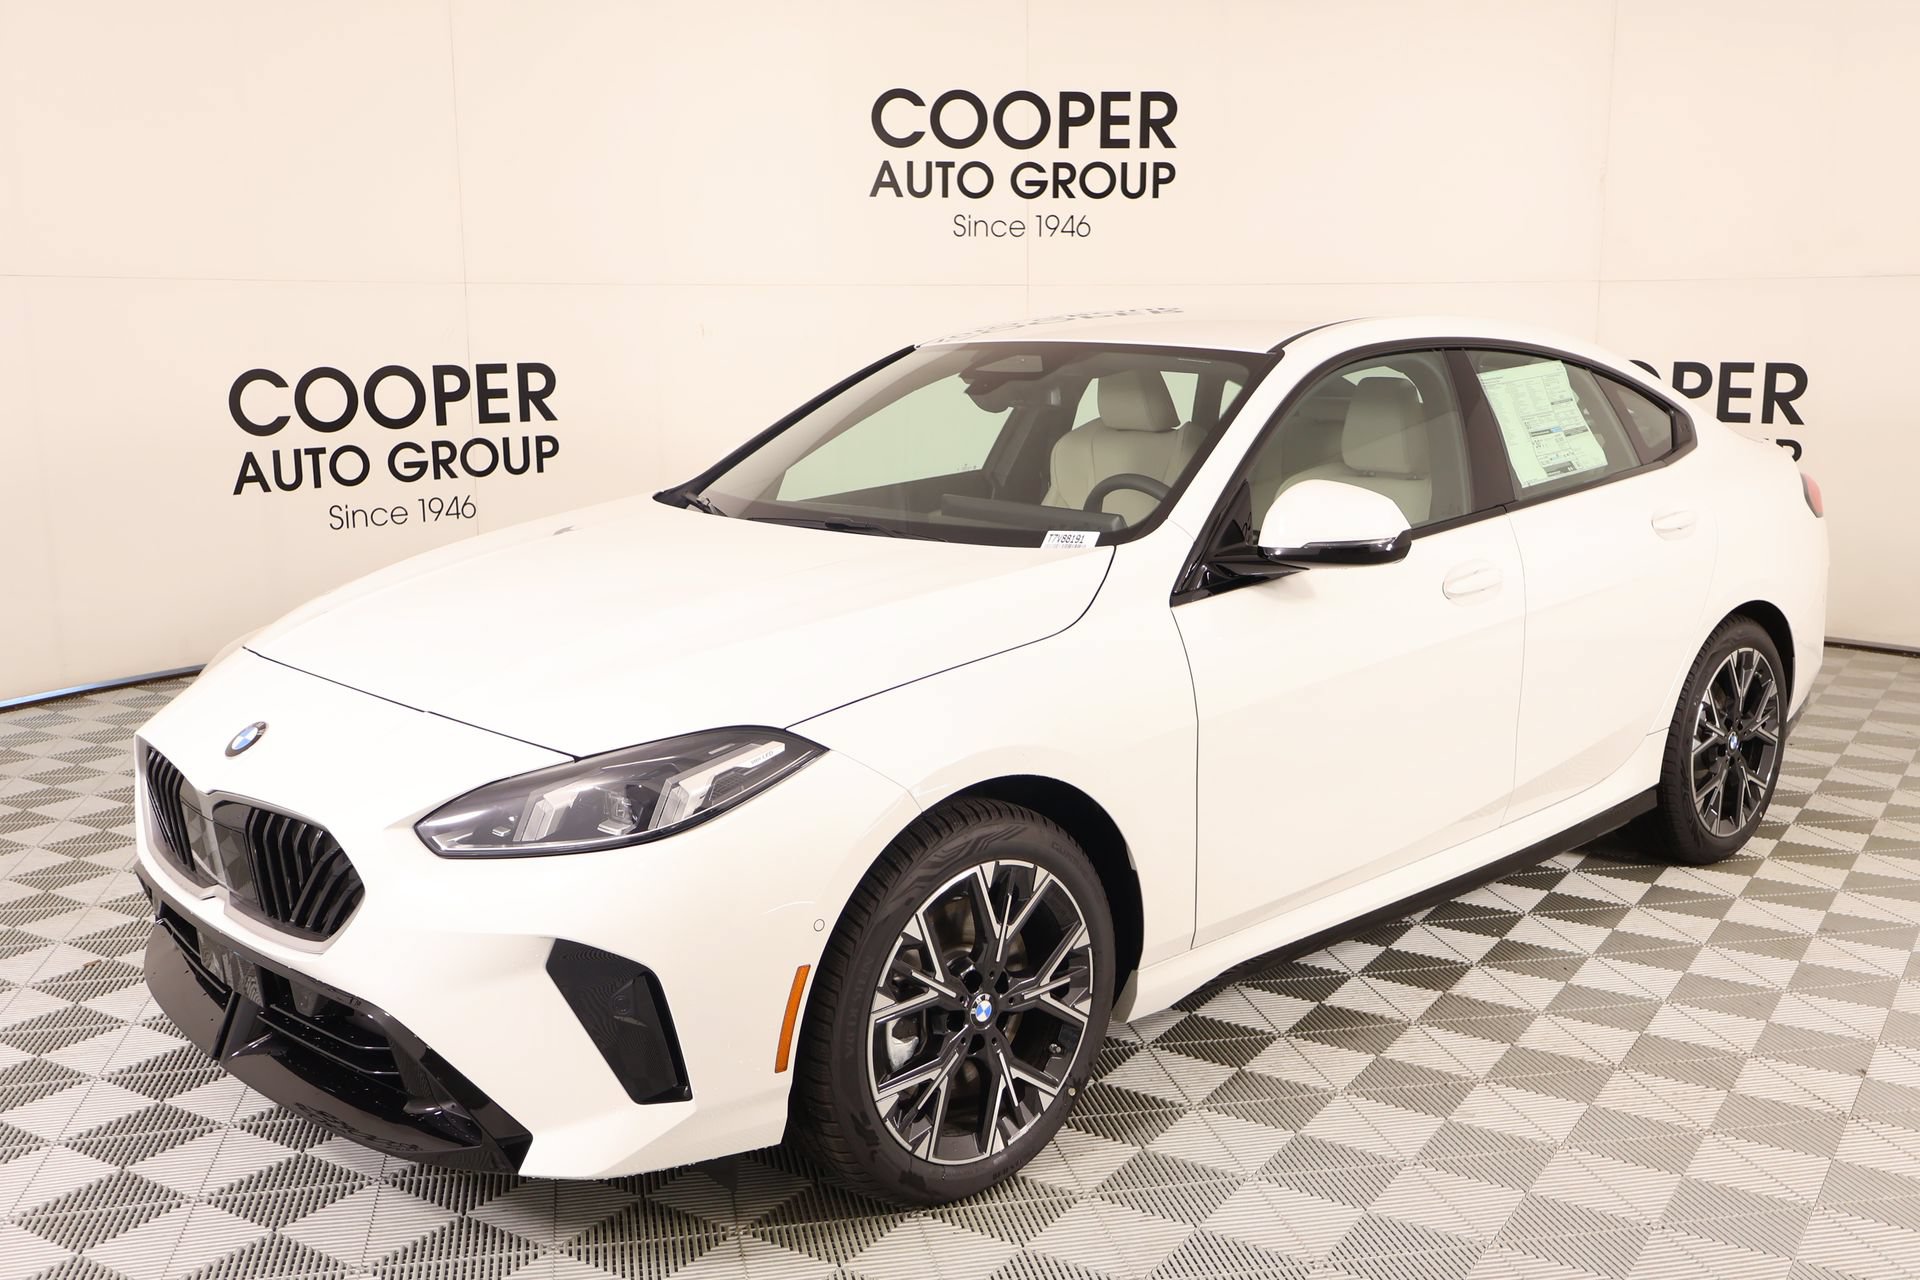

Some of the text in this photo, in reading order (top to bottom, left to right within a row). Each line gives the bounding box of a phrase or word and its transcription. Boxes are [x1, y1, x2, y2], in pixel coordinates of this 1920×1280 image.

[871, 88, 1177, 150] COOPER
[870, 160, 1176, 199] AUTO GROUP
[953, 214, 1091, 237] Since 1946
[228, 362, 558, 437] COOPER
[1629, 359, 1809, 425] PER
[233, 434, 560, 495] AUTO GROUP
[328, 494, 477, 530] Since 1946
